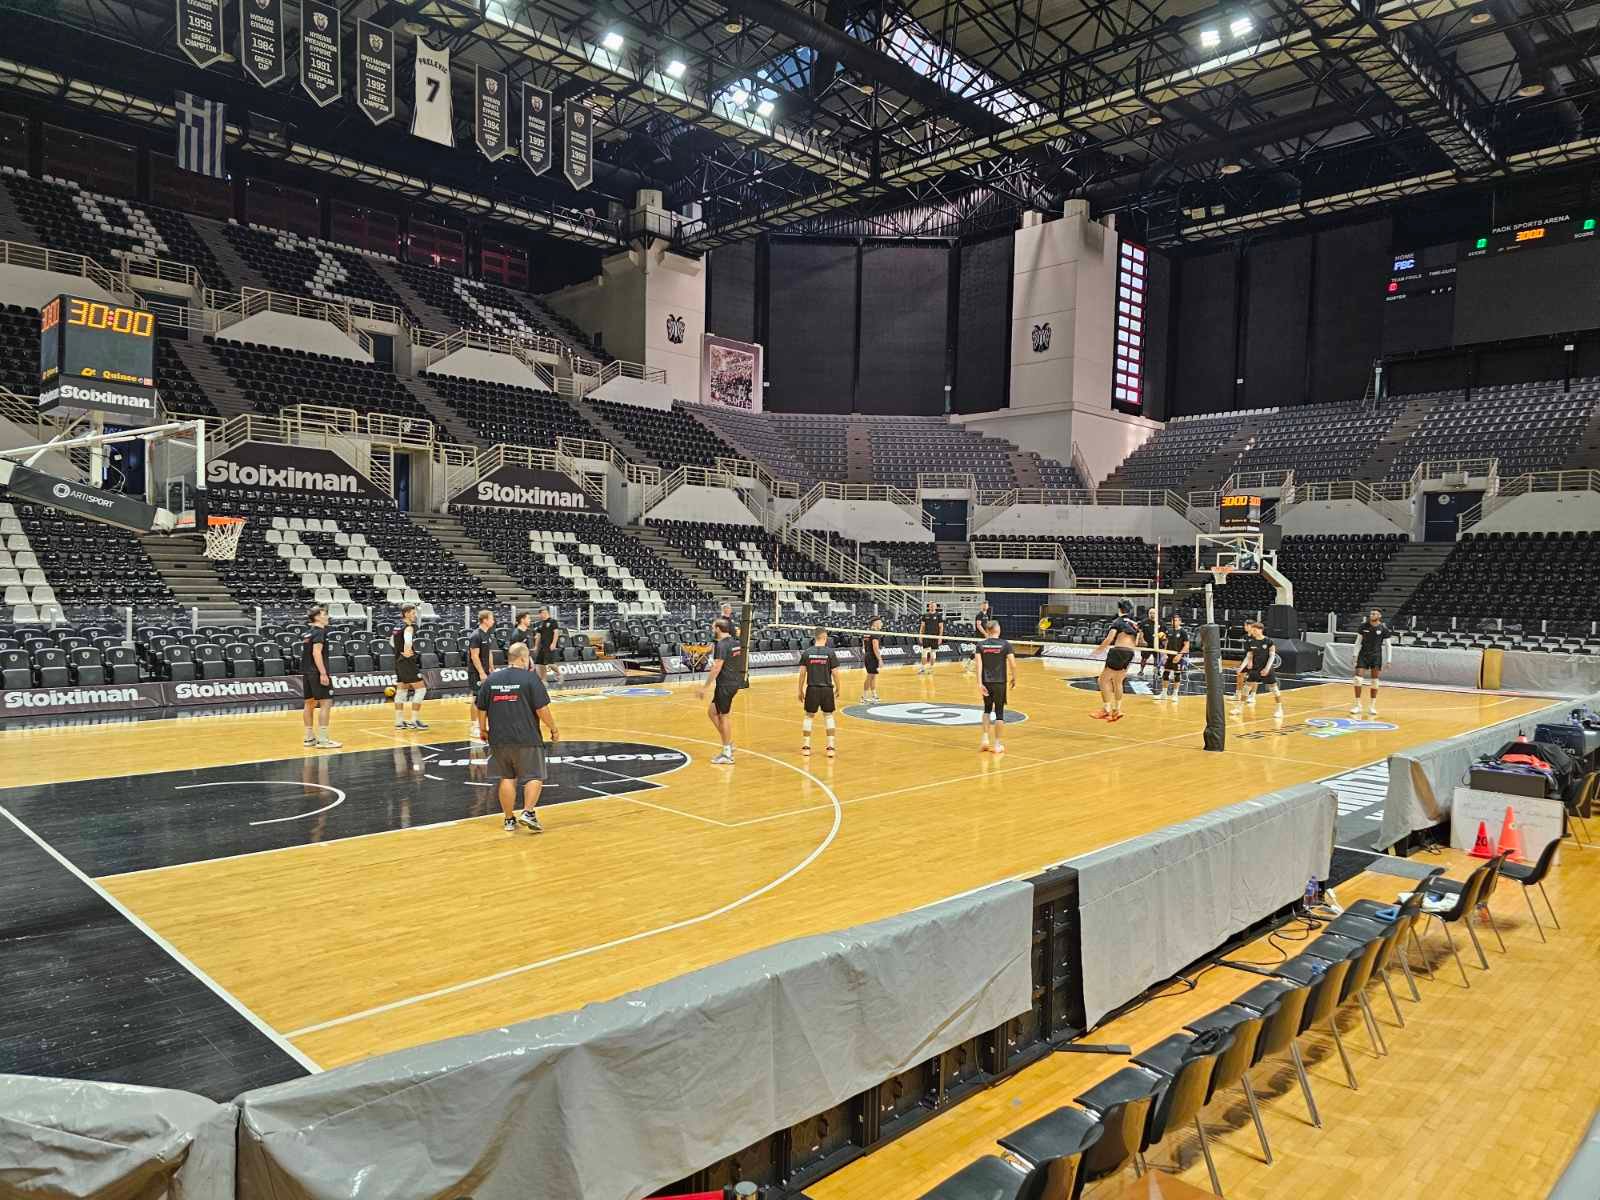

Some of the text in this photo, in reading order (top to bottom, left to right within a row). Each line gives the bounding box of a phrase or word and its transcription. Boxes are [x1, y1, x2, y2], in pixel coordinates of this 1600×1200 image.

[189, 15, 212, 31] 1959
[185, 38, 217, 53] CHAMPION
[252, 37, 274, 53] 1984
[311, 57, 331, 73] 1991
[366, 78, 386, 93] 1992
[426, 77, 440, 103] 7
[483, 118, 500, 131] 1994
[1492, 214, 1570, 234] PAOK SPORTS ARENA
[68, 299, 154, 337] 30:00
[60, 384, 150, 409] Stoiximan
[207, 459, 357, 493] Stoiximan
[478, 481, 585, 508] Stoiximan
[4, 687, 140, 709] Stoiximan
[175, 680, 289, 699] Stoiximan
